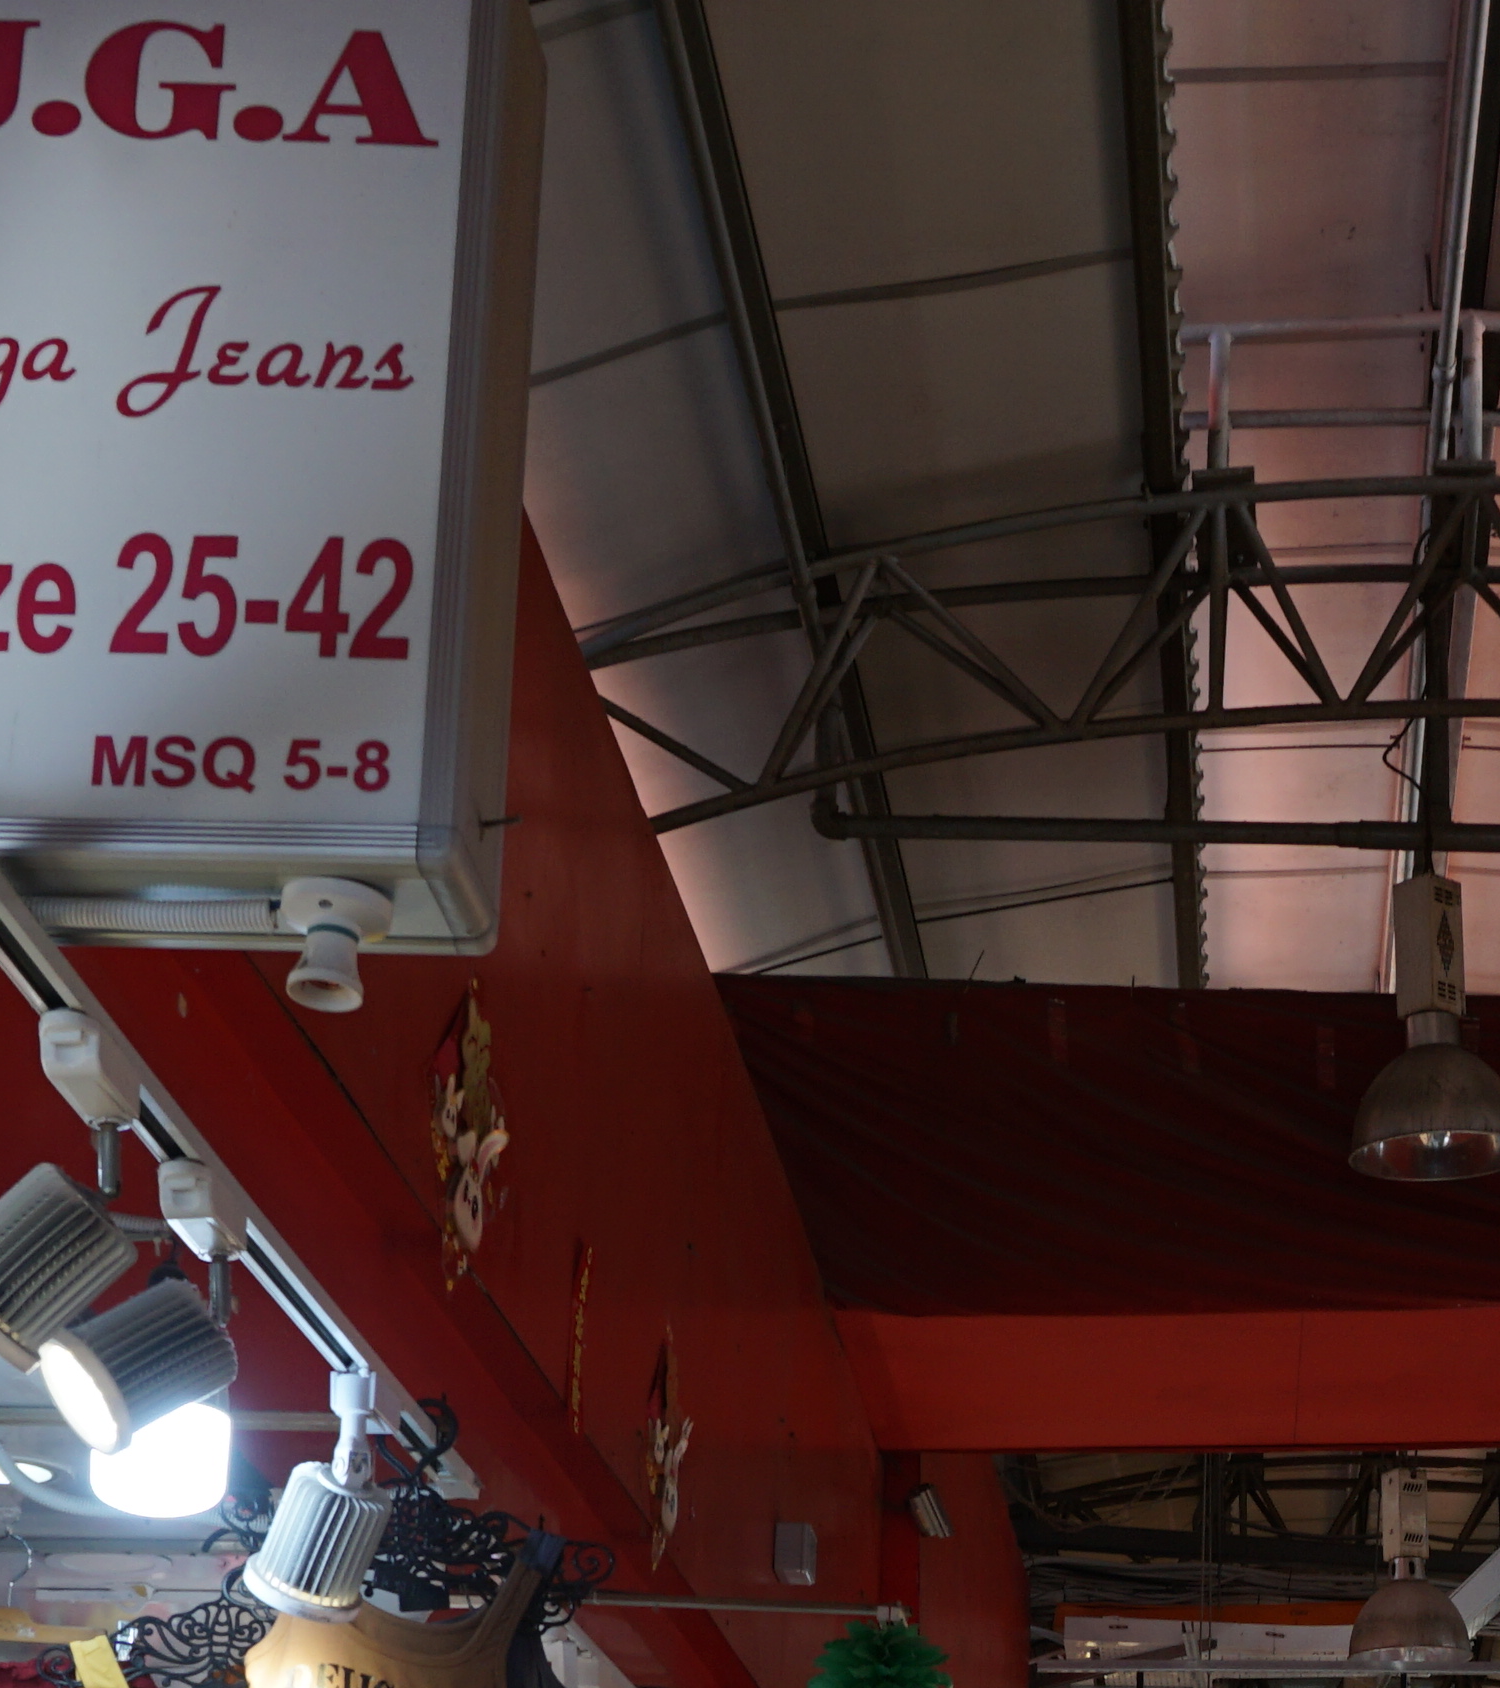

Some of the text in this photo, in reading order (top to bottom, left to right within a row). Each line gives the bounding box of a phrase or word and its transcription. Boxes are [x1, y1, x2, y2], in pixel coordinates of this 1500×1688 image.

[116, 285, 414, 417] Jeans
[108, 532, 414, 660] 25-42
[91, 735, 391, 793] MSQ 5-8
